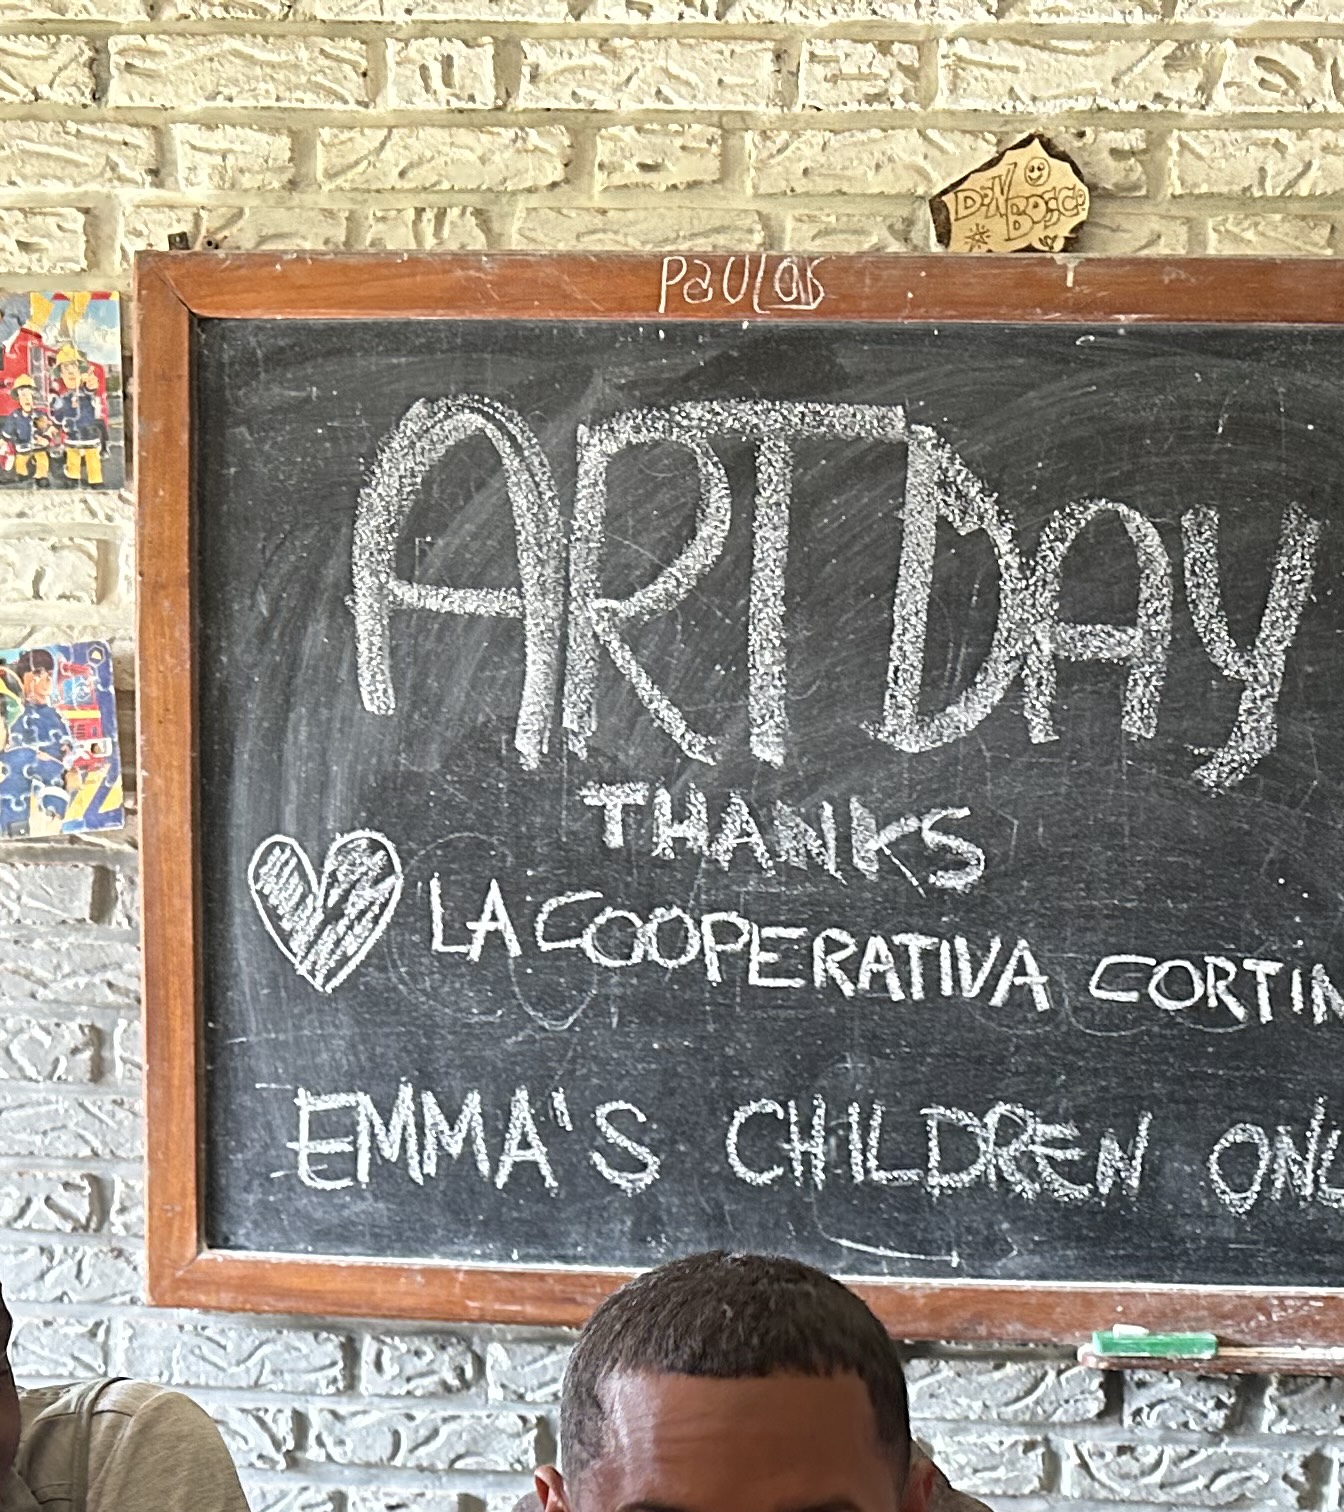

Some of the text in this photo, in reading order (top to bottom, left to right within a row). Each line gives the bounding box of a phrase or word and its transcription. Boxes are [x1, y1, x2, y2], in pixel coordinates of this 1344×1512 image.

[346, 394, 906, 771] ART
[579, 781, 985, 897] THANKS
[429, 873, 522, 962] LA
[534, 891, 1050, 1012] COOPERATIVA
[286, 1076, 660, 1196] EMMA'S
[726, 1093, 1153, 1204] CHILDREN
